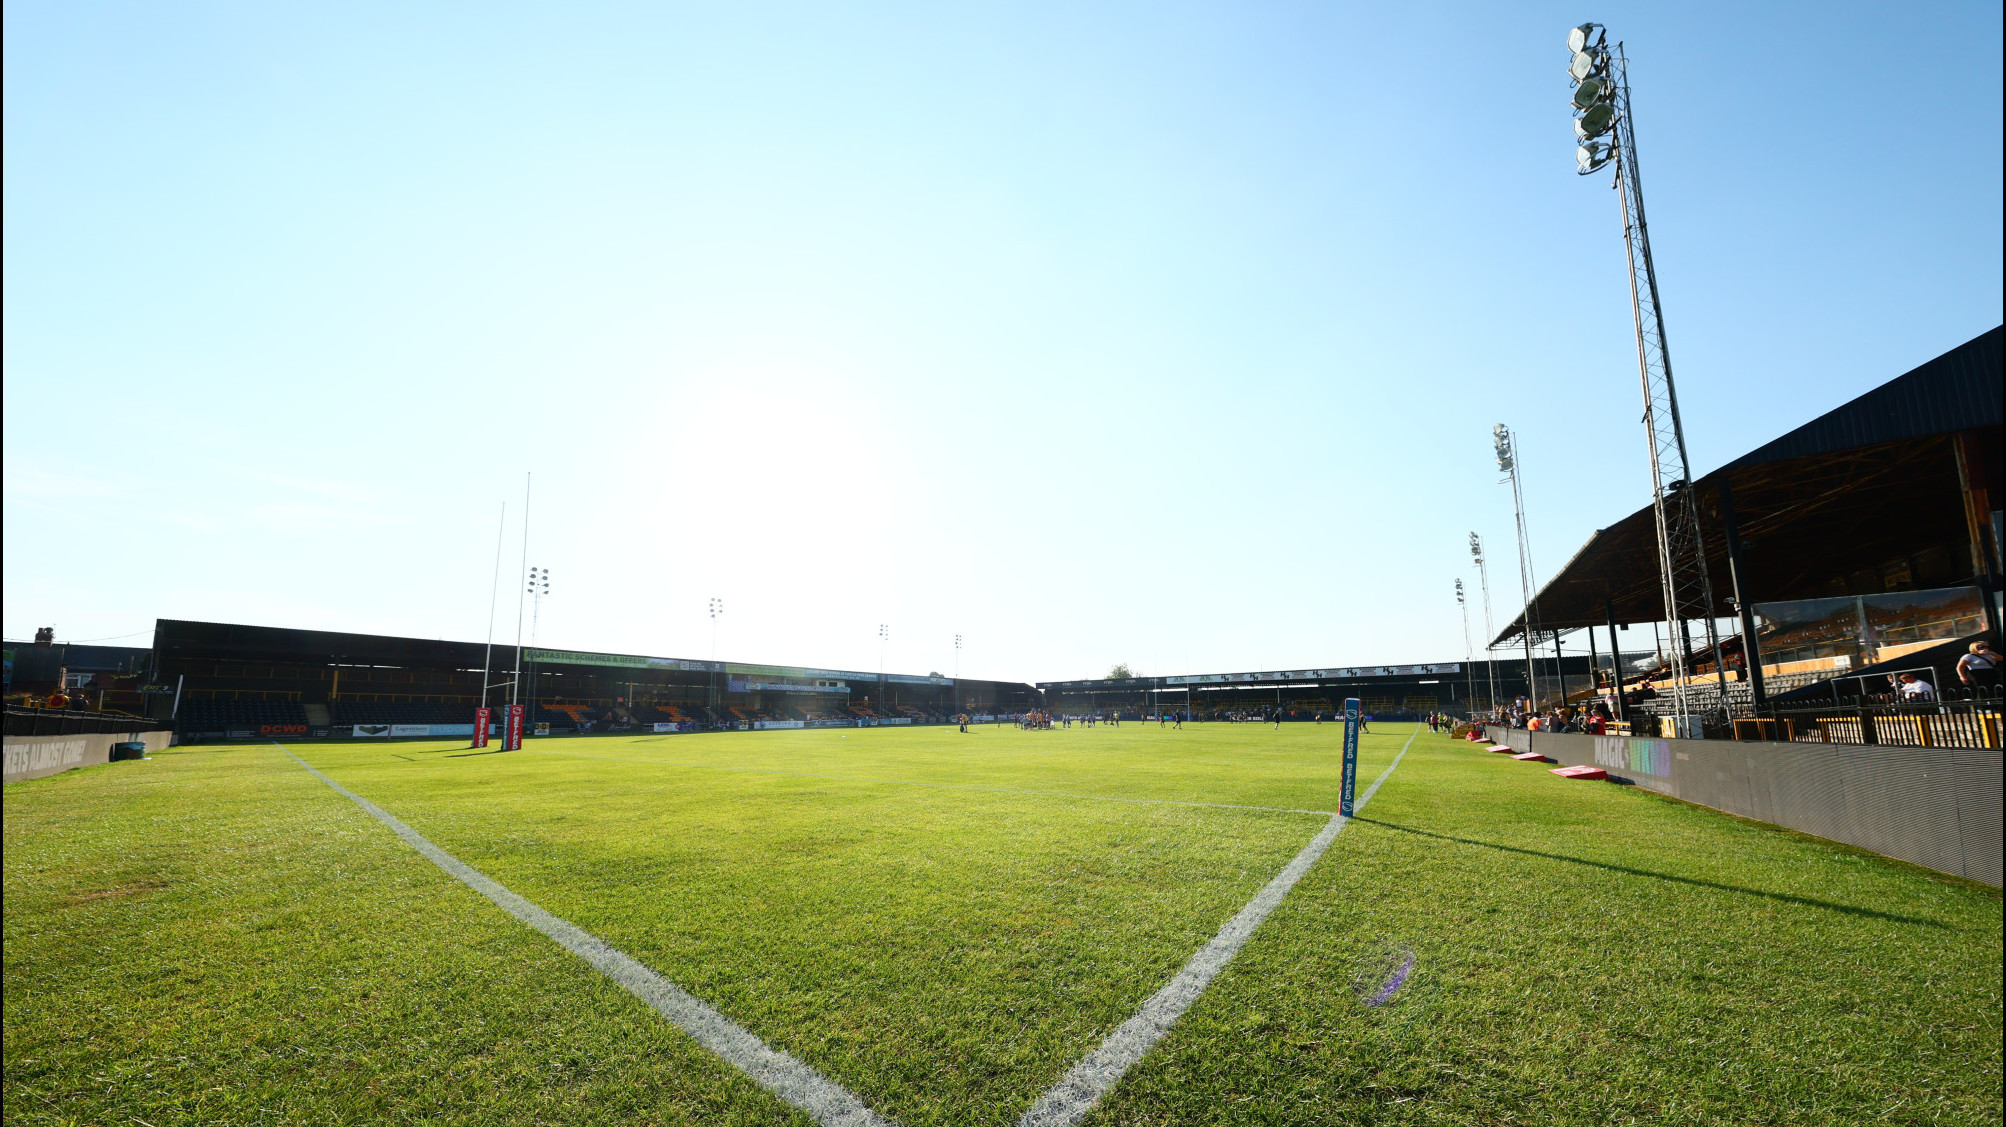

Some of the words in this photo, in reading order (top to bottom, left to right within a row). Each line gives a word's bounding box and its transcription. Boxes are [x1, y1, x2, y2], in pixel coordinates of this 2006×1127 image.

[527, 650, 573, 659] FANTASTIC
[575, 653, 611, 662] SCHEMES
[260, 724, 308, 733] DCWD
[478, 717, 486, 748] BETFRED
[512, 716, 520, 750] BETFRED
[29, 742, 65, 771] ALMOST
[1594, 737, 1625, 770] MAGIC
[1345, 763, 1353, 800] BETFRED
